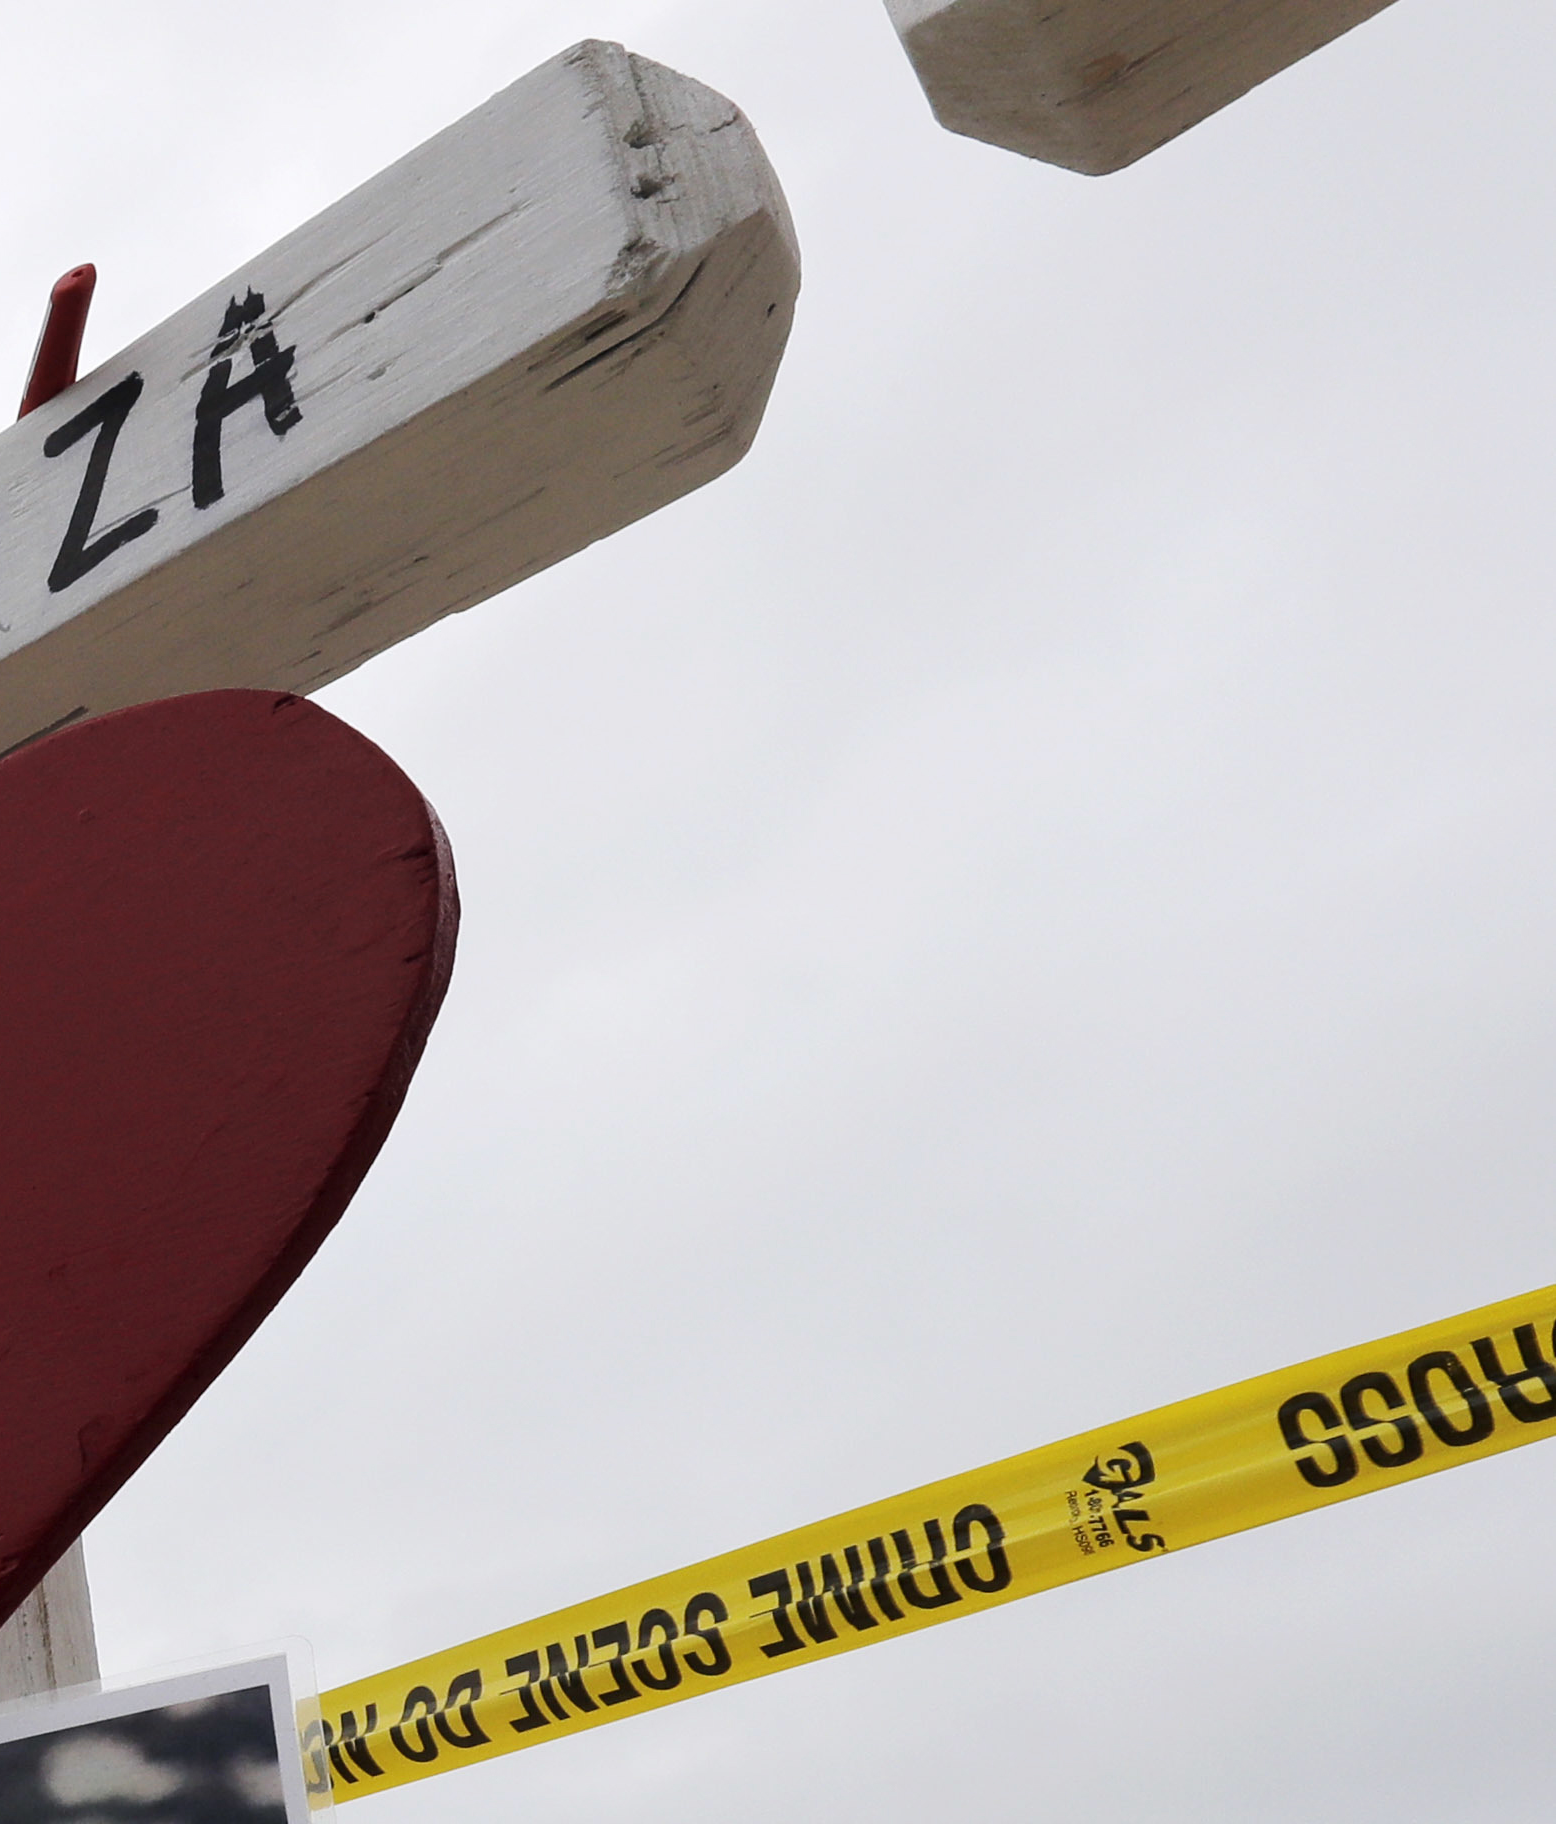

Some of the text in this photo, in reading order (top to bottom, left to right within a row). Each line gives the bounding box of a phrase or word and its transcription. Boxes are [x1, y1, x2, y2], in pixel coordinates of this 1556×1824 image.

[1278, 1318, 1556, 1488] ROSS
[302, 1503, 1013, 1795] CRIME SCENE DO NO
